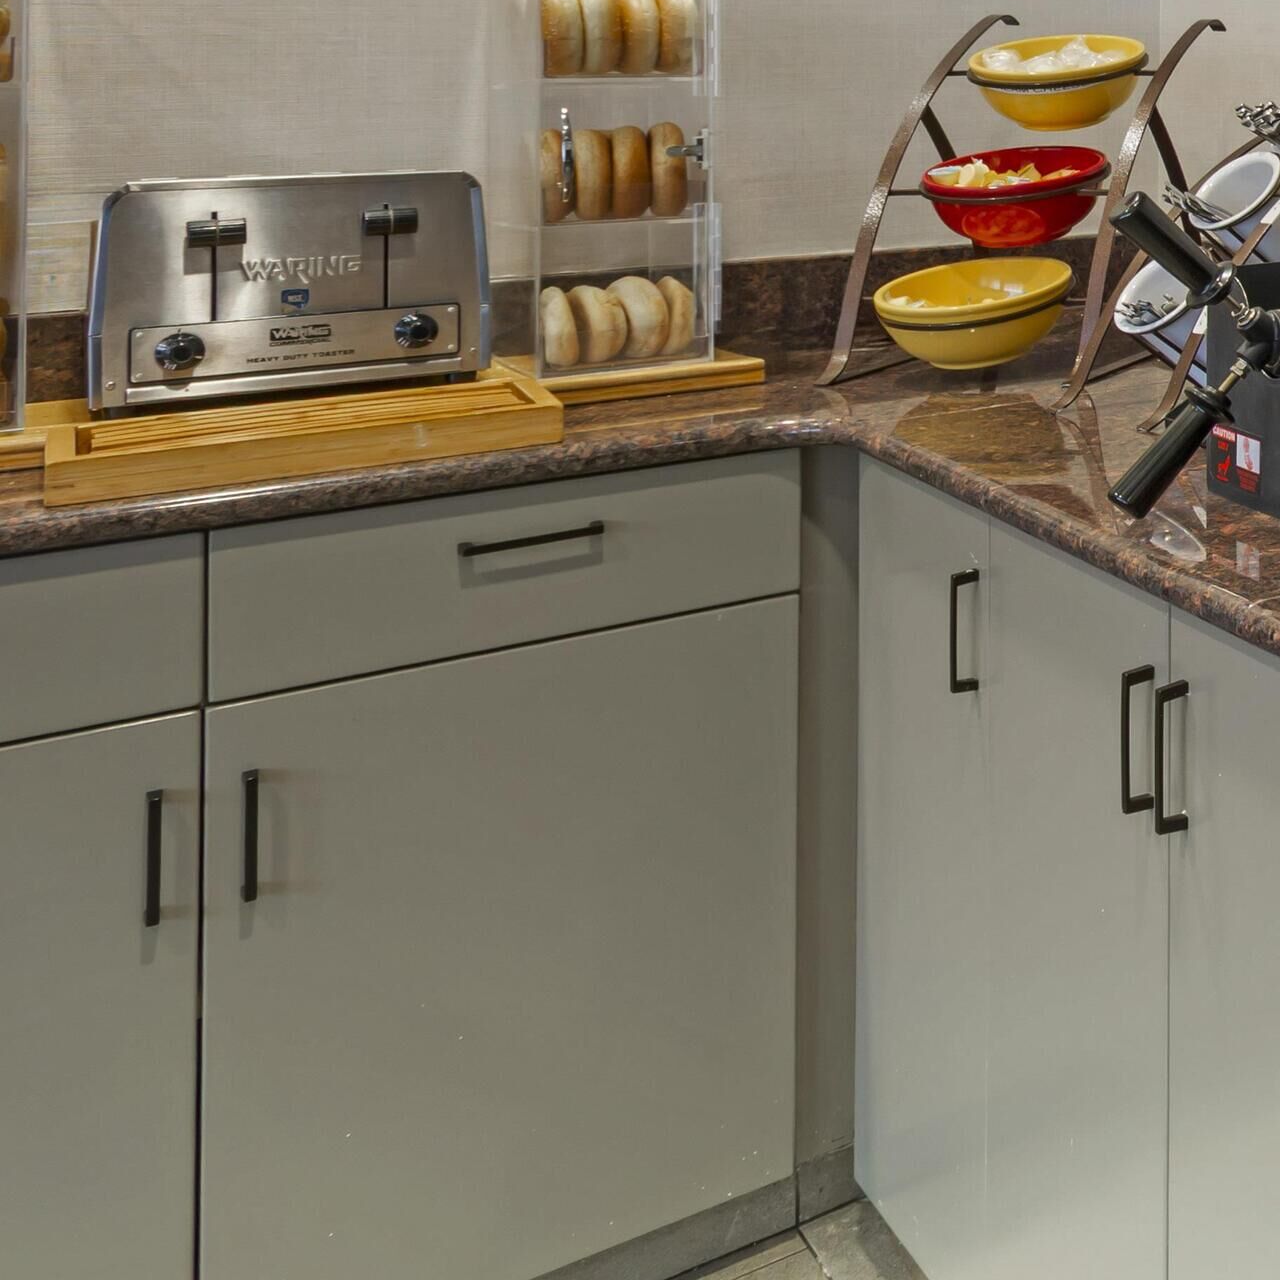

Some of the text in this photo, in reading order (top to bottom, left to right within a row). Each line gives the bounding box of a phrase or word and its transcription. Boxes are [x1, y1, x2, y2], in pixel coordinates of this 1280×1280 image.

[239, 255, 361, 284] WARING
[246, 349, 355, 364] HEAVY DUTY TOASTER
